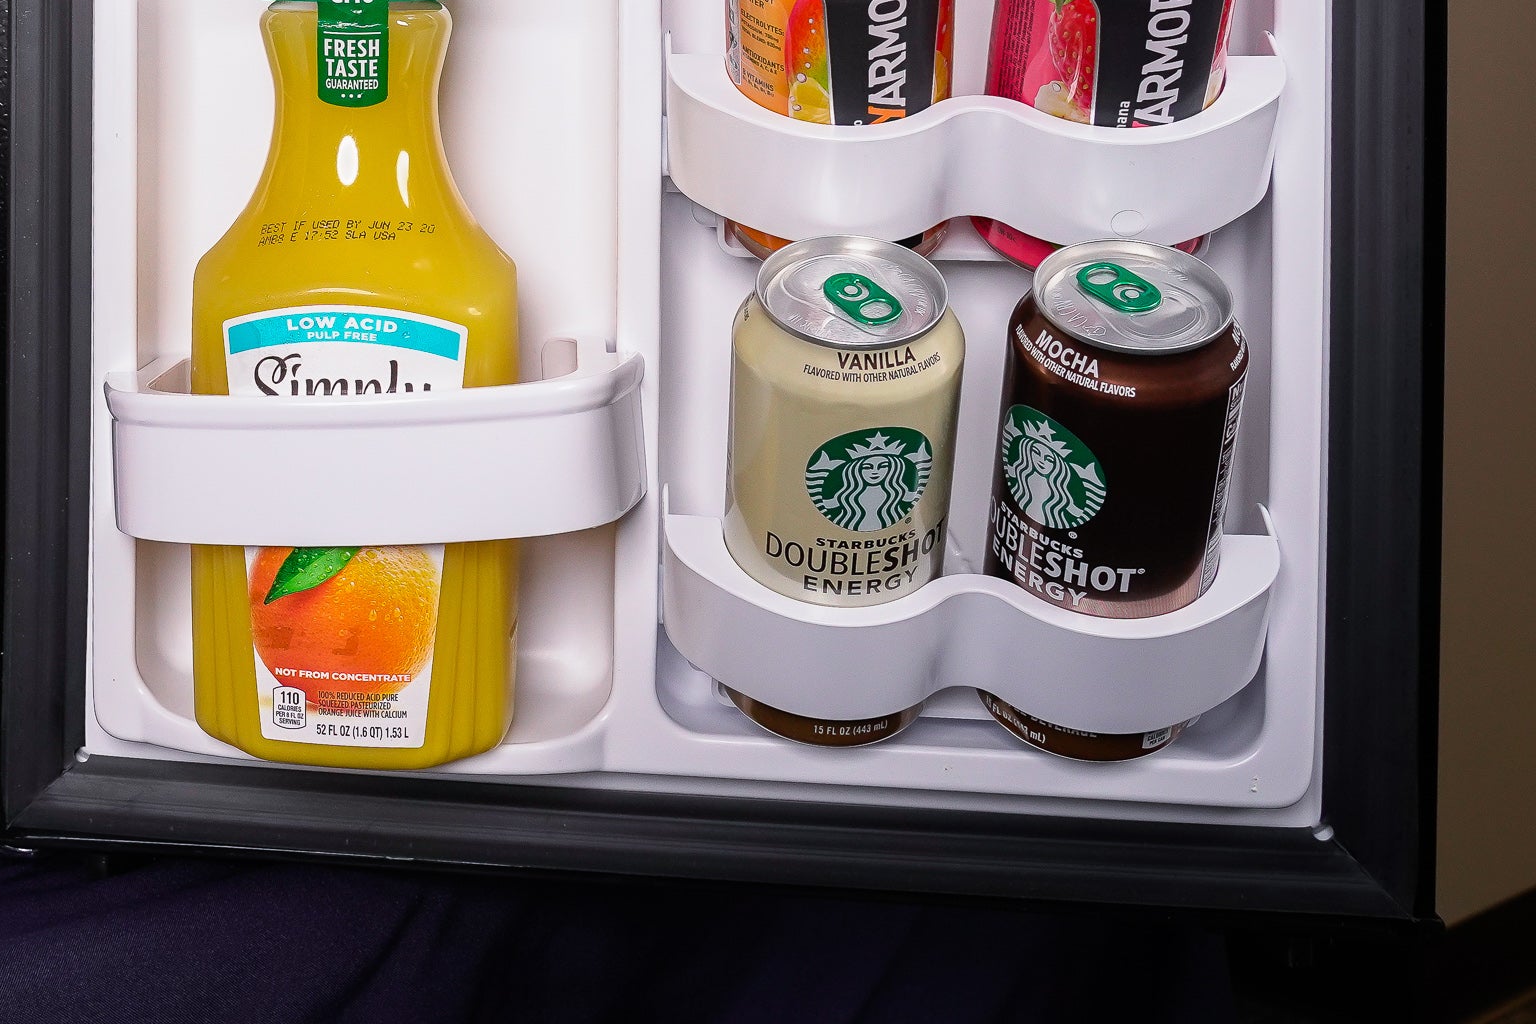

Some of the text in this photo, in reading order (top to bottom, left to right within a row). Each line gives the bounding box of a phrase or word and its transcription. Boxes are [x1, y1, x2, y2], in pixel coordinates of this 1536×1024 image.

[324, 39, 380, 57] FRESH
[326, 59, 378, 77] TASTE
[326, 78, 378, 90] GUARANTEED
[261, 219, 435, 235] BEST IF USED BY JUN 23 20
[286, 316, 398, 333] LOW ACID
[307, 331, 377, 341] PULP FREE
[837, 346, 916, 370] VANILLA
[1035, 329, 1099, 378] MOCHA
[804, 352, 941, 382] FLAVORED WITH OTHER NATURAL FLAVORS
[1001, 501, 1083, 558] STARBUCKS
[766, 516, 945, 576] DOUBLESHOT
[816, 529, 916, 550] STARBUCKS
[992, 534, 1087, 606] ENERGY
[803, 565, 919, 596] ENERGY
[275, 667, 411, 682] NOT FROM CONCENTRATE
[280, 691, 299, 705] 110
[316, 724, 409, 740] 52 FL OZ (1.6 QT) 1.53 L
